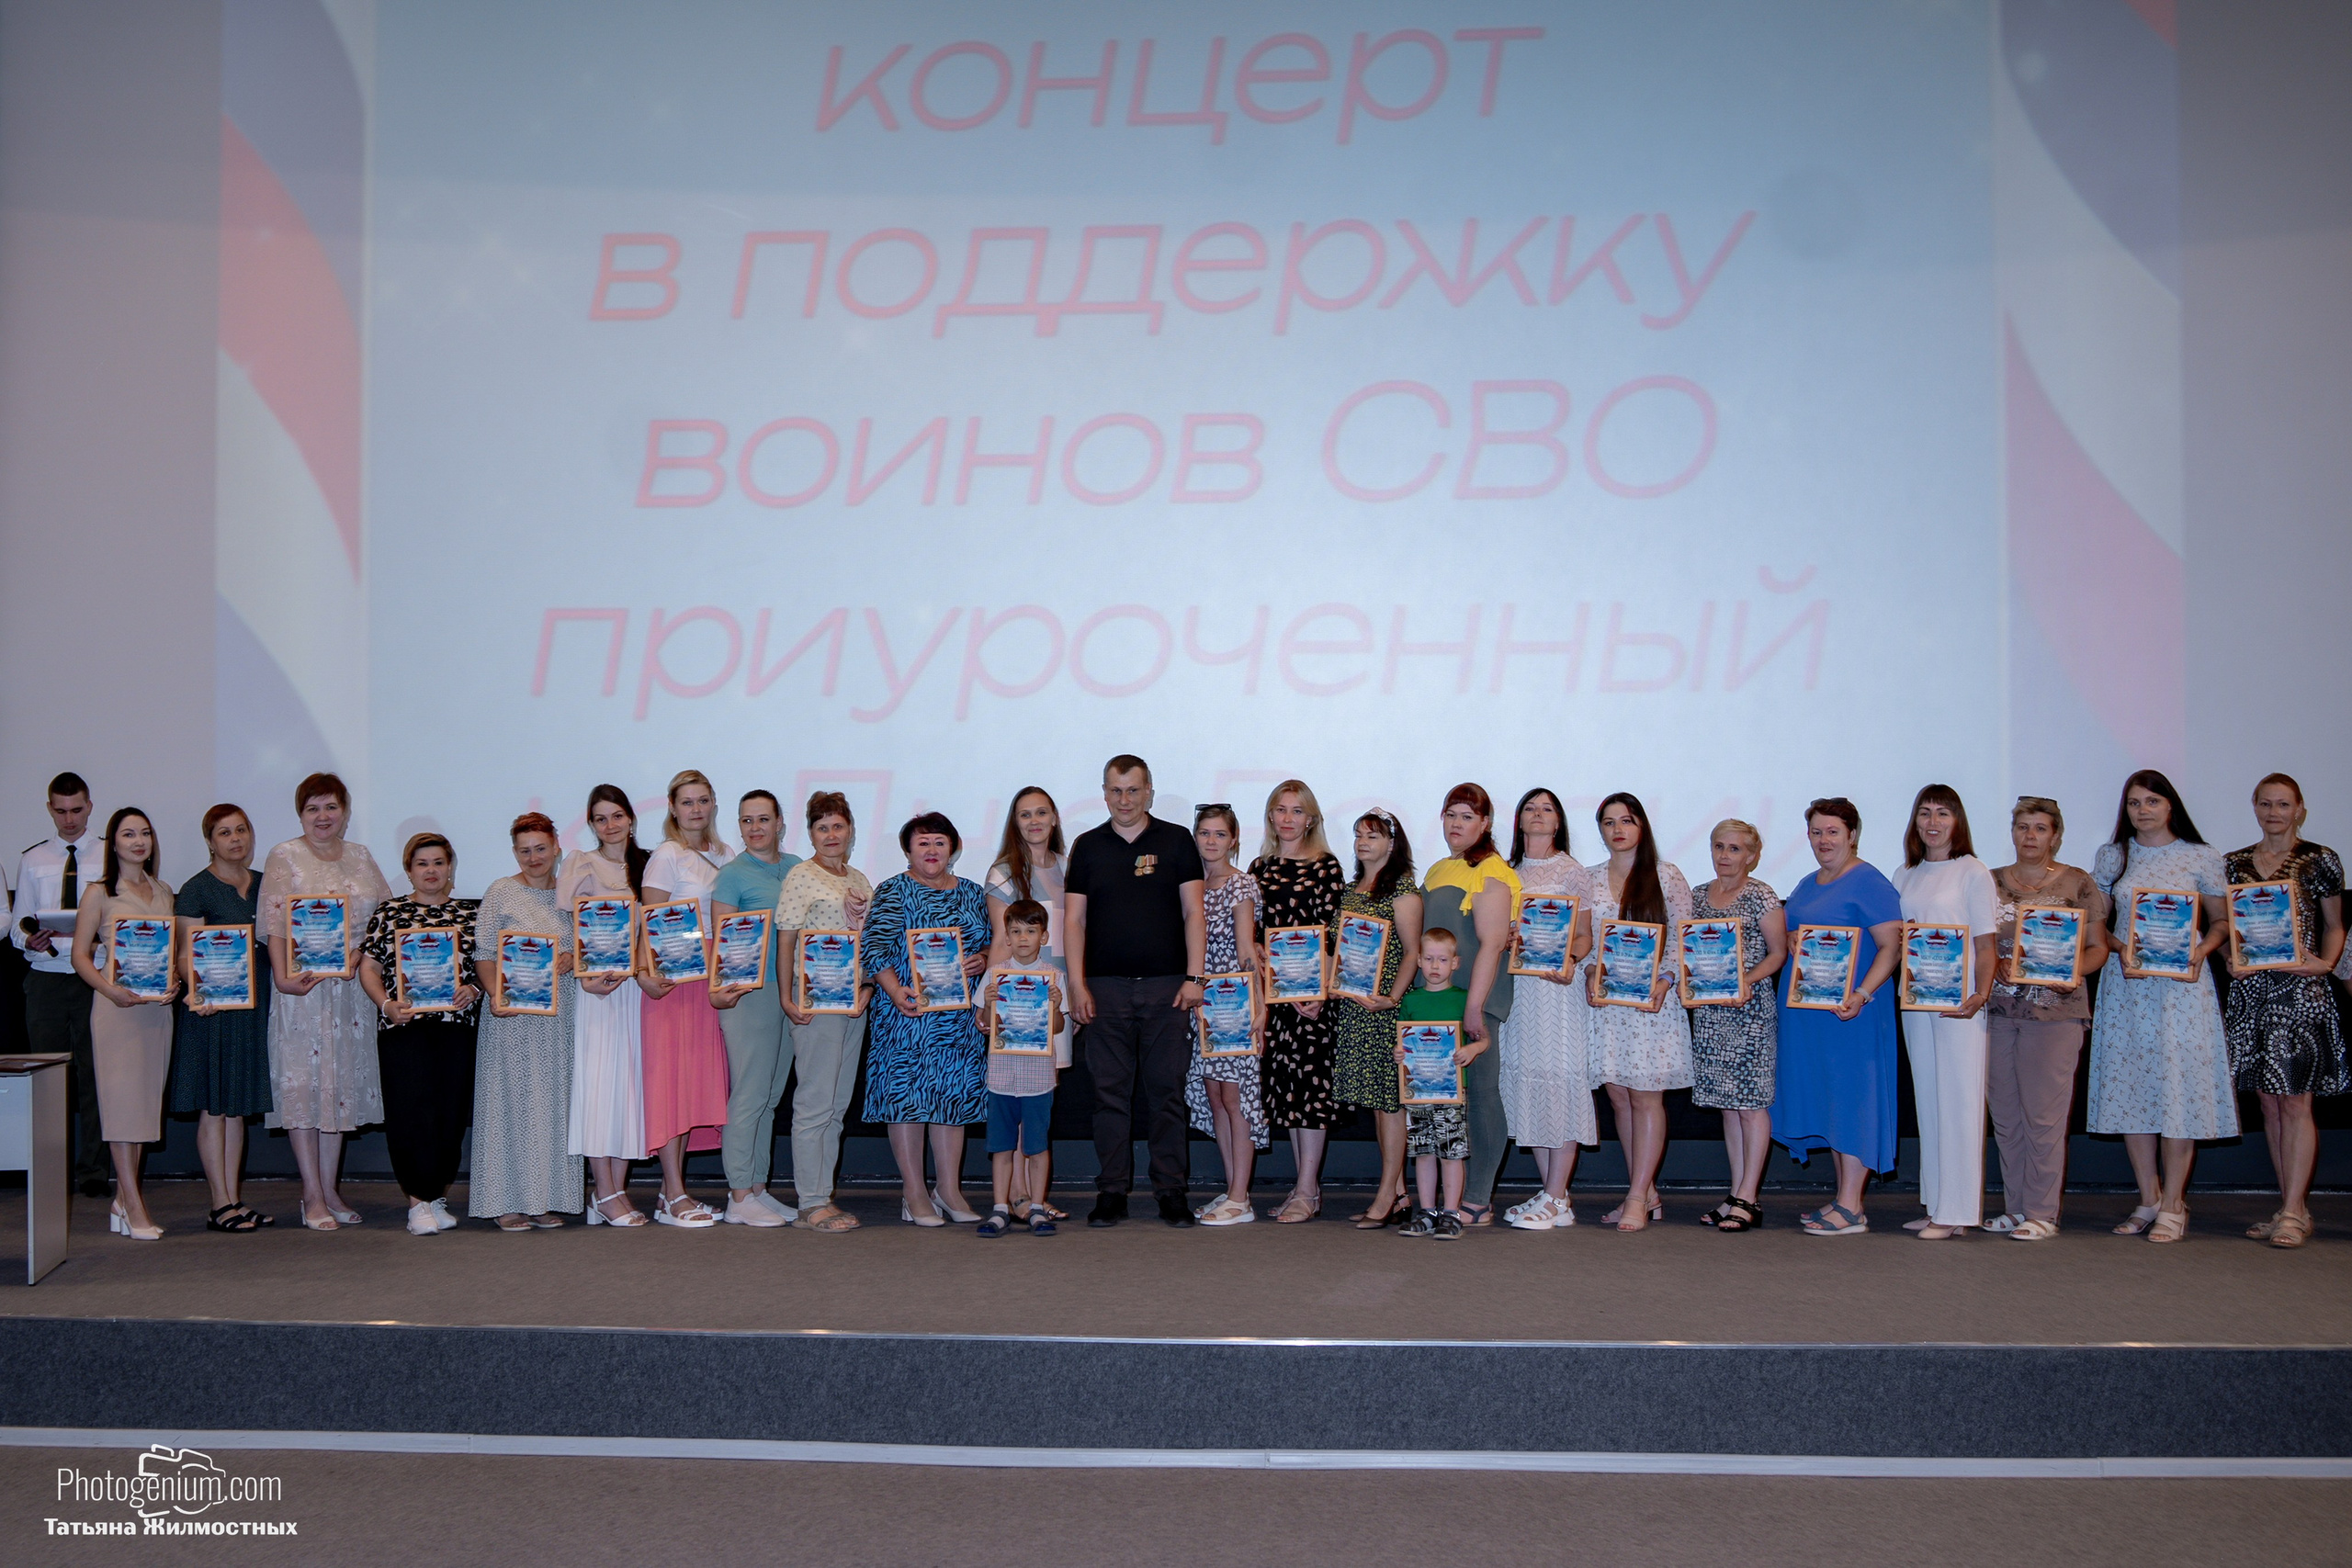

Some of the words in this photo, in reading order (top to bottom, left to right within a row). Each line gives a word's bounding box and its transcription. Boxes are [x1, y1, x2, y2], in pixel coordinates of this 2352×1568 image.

[813, 24, 1546, 147] концерт
[586, 231, 684, 323] в
[729, 209, 1758, 340] поддержку
[632, 411, 1267, 511] воинов
[1319, 373, 1719, 504] СВО
[529, 564, 1829, 725] приуроченный
